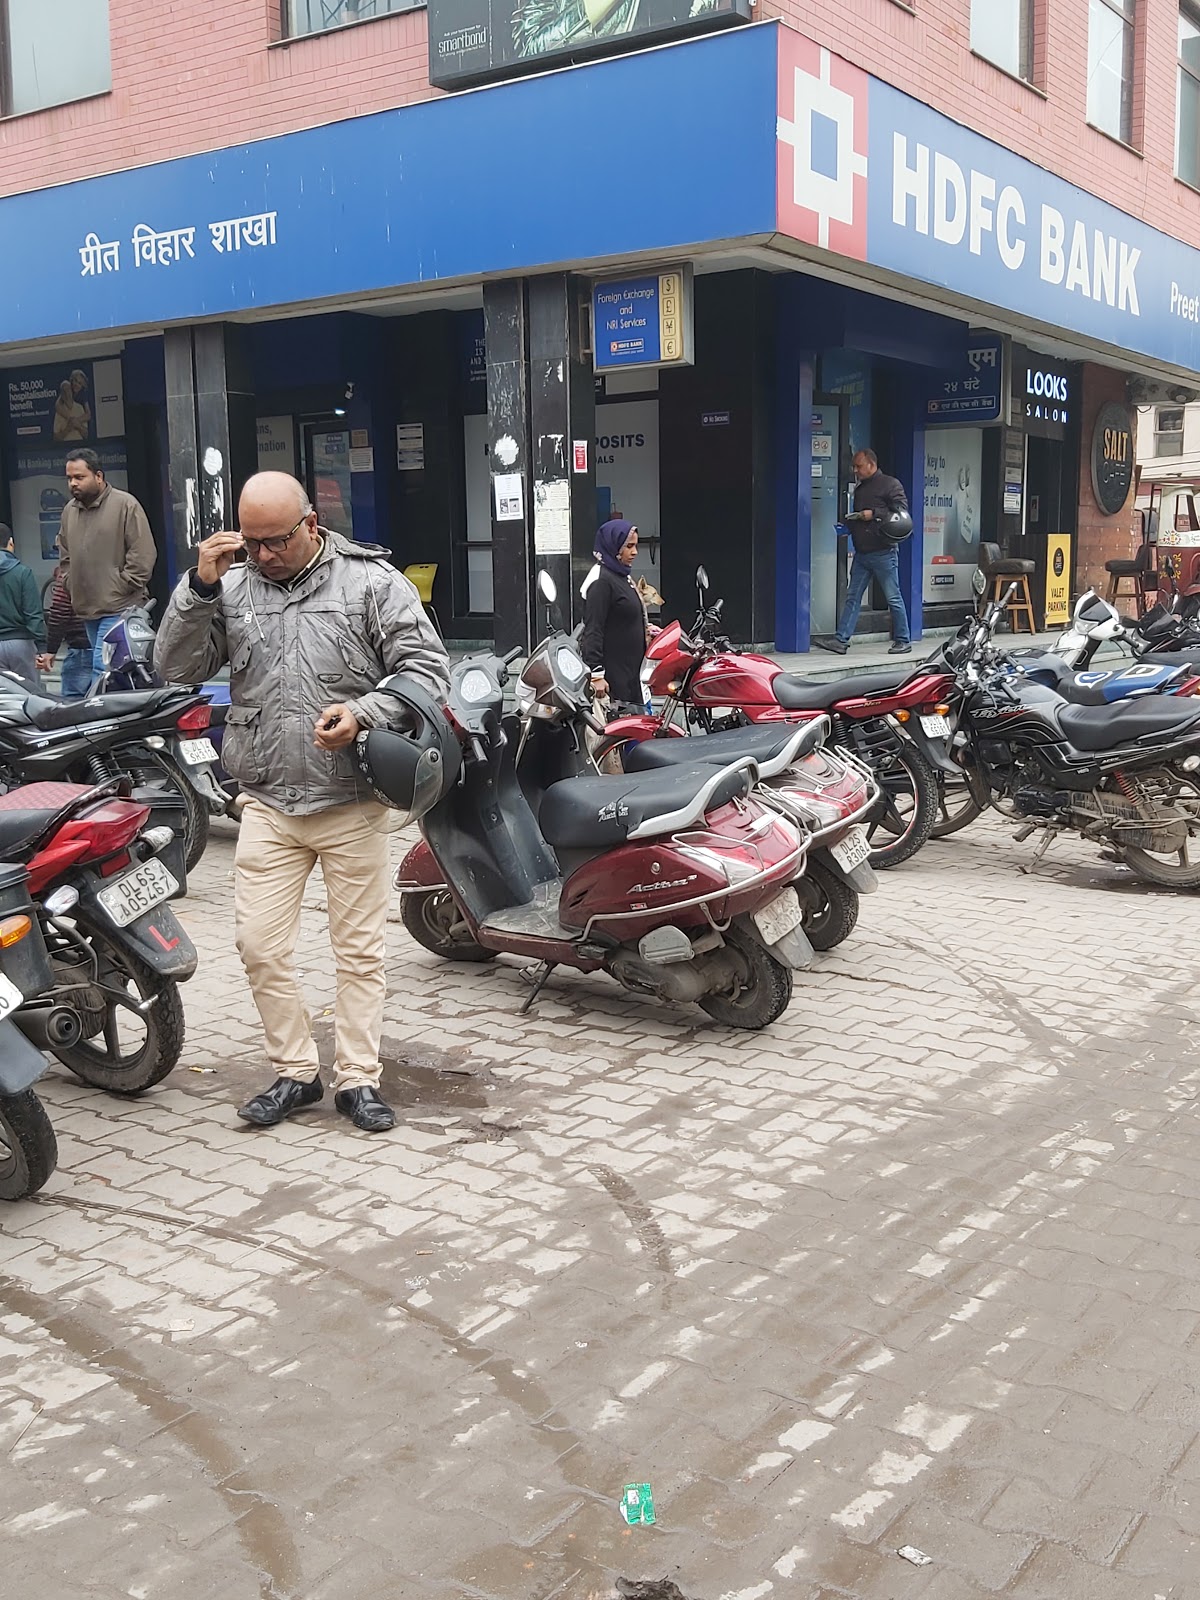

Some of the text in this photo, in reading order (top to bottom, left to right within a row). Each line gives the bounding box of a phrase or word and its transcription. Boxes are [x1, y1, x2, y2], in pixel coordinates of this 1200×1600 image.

[439, 26, 486, 54] smartbond
[893, 130, 1199, 323] HDFC BANK Preet
[79, 211, 278, 276] प्रीत विहार शाखा
[598, 288, 654, 304] Foreign Exchange
[620, 303, 632, 315] and
[606, 318, 646, 330] NRI Services
[968, 348, 998, 372] एम
[8, 380, 44, 392] Rs. 50,000
[944, 378, 981, 394] २४ घंटे
[1026, 368, 1068, 402] LOOKS
[9, 388, 57, 402] hospitalisation
[10, 400, 33, 411] benefit
[1026, 403, 1068, 424] SALON
[259, 440, 286, 452] nation
[1104, 428, 1128, 462] SALT
[927, 454, 946, 470] key to
[924, 474, 940, 489] plete
[930, 494, 936, 506] of
[938, 494, 952, 508] mind
[1050, 588, 1064, 598] VALET
[1048, 601, 1066, 612] PARKING
[840, 834, 860, 854] DL2S
[118, 867, 156, 898] DL6S
[148, 925, 180, 952] L
